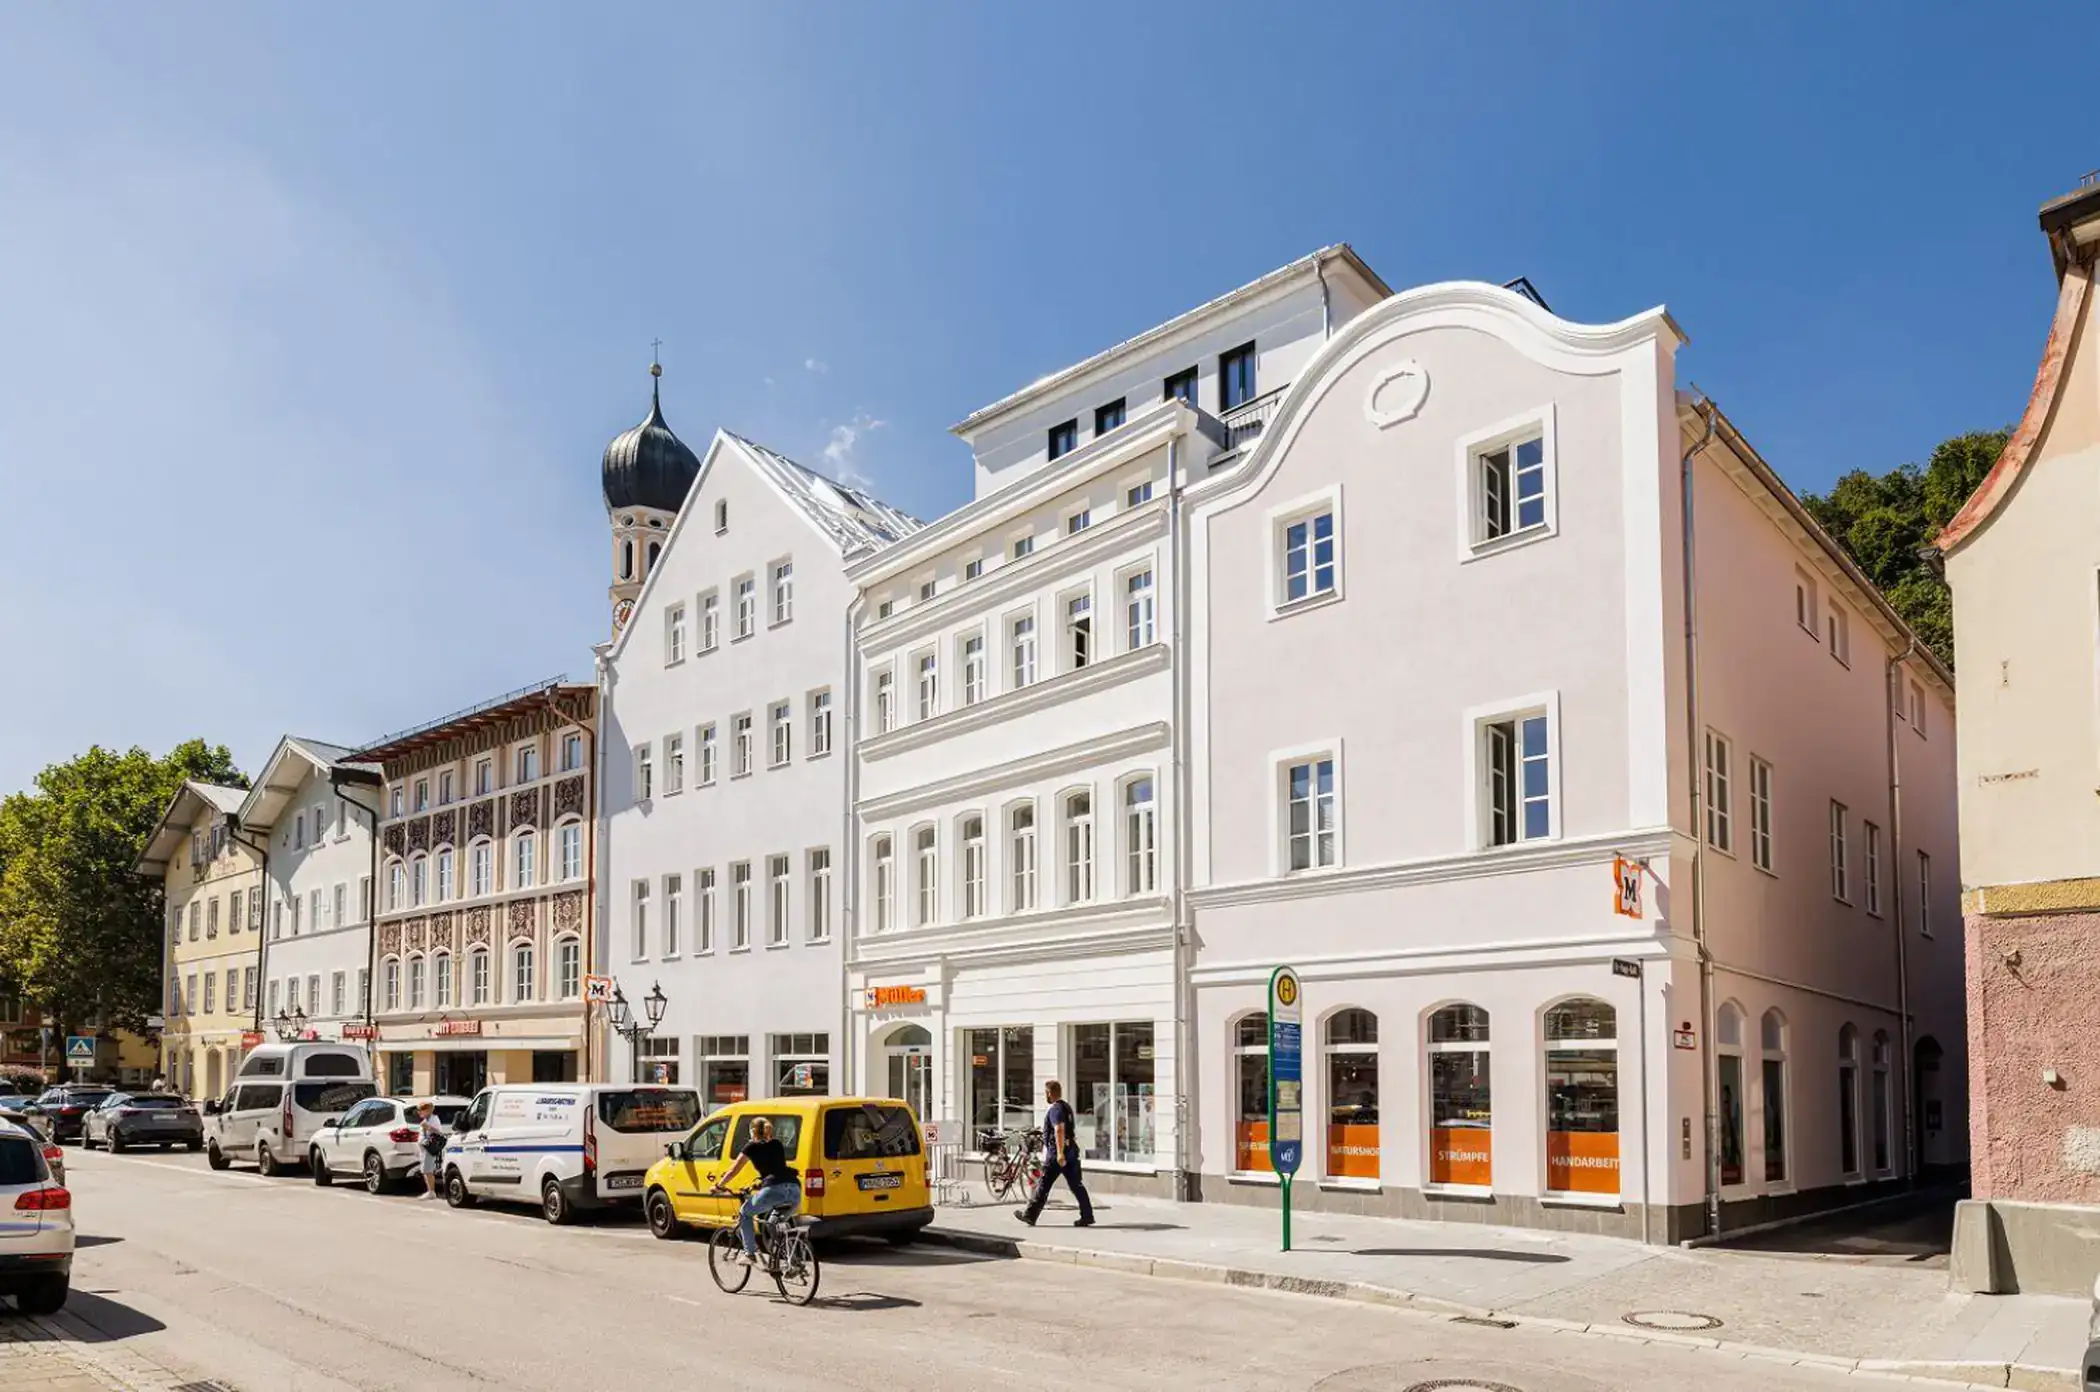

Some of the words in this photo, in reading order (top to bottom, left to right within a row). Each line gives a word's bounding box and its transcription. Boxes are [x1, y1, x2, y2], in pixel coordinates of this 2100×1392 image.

[1624, 876, 1637, 903] M
[592, 984, 605, 996] M
[1438, 1148, 1489, 1163] STRÜMPFE
